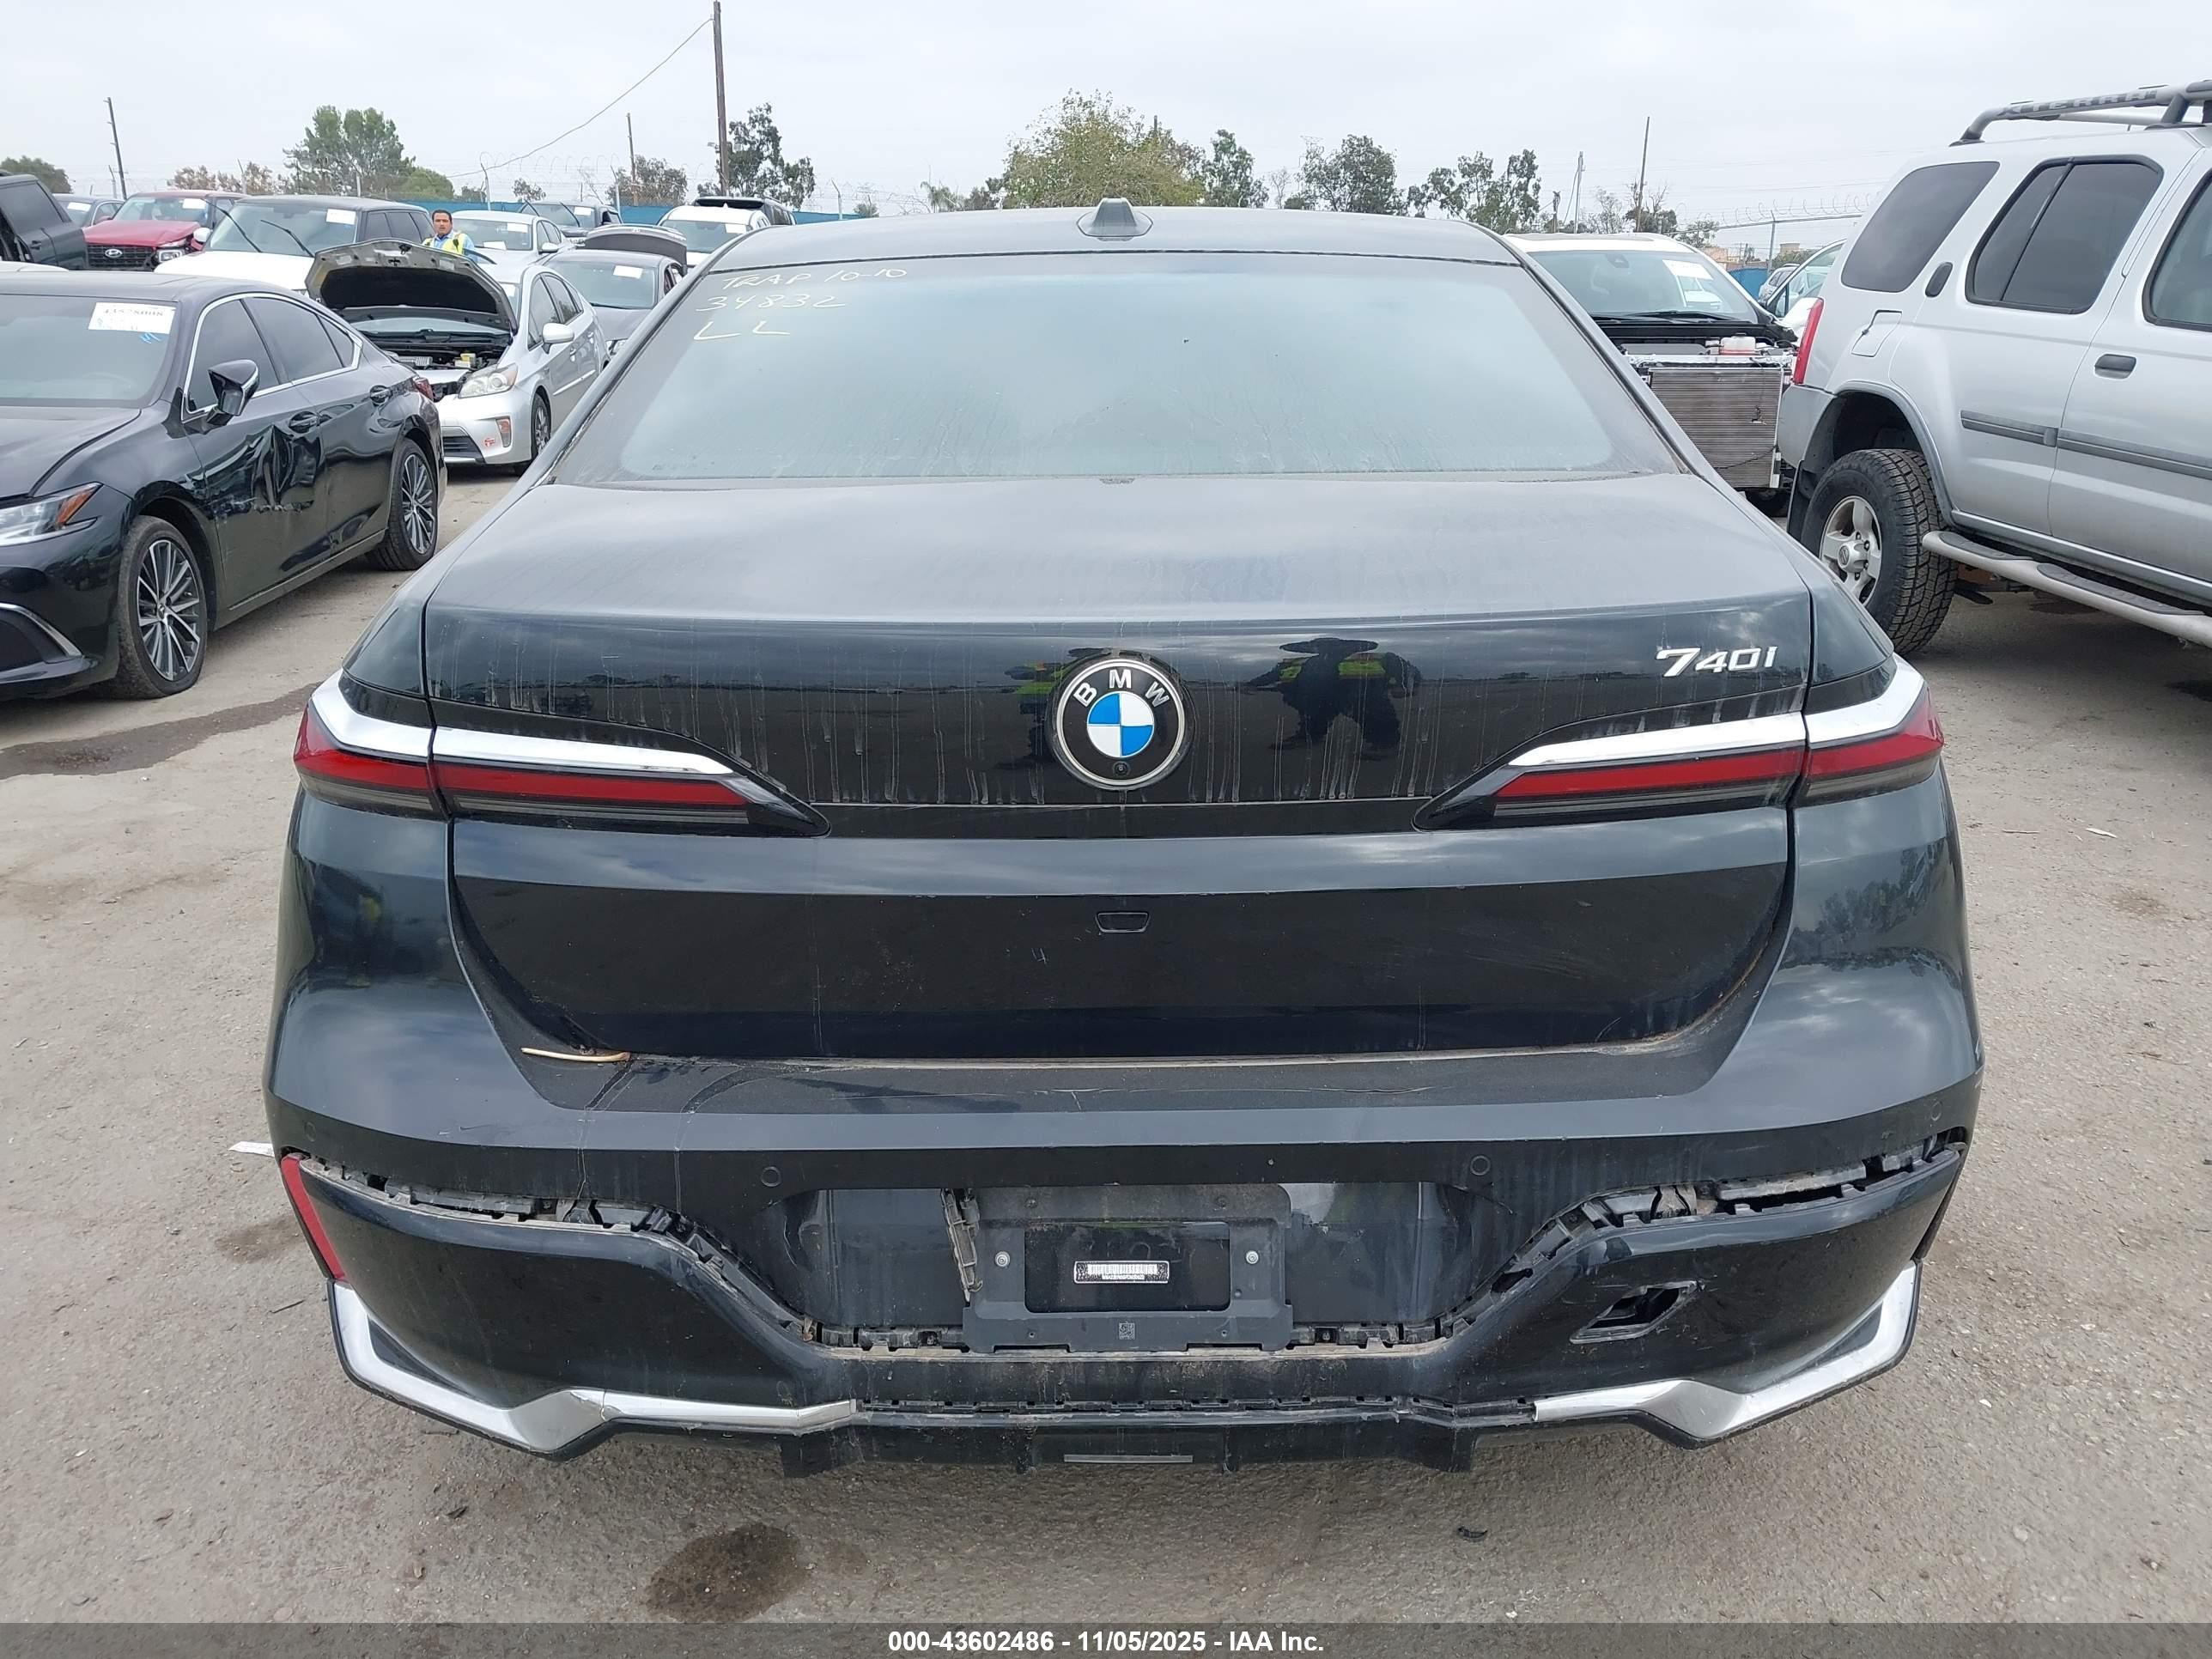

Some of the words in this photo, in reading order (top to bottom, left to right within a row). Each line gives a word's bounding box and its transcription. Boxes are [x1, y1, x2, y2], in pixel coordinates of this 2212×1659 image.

[722, 273, 811, 290] TRAP
[823, 268, 908, 283] 10-10
[1073, 669, 1170, 708] BMW
